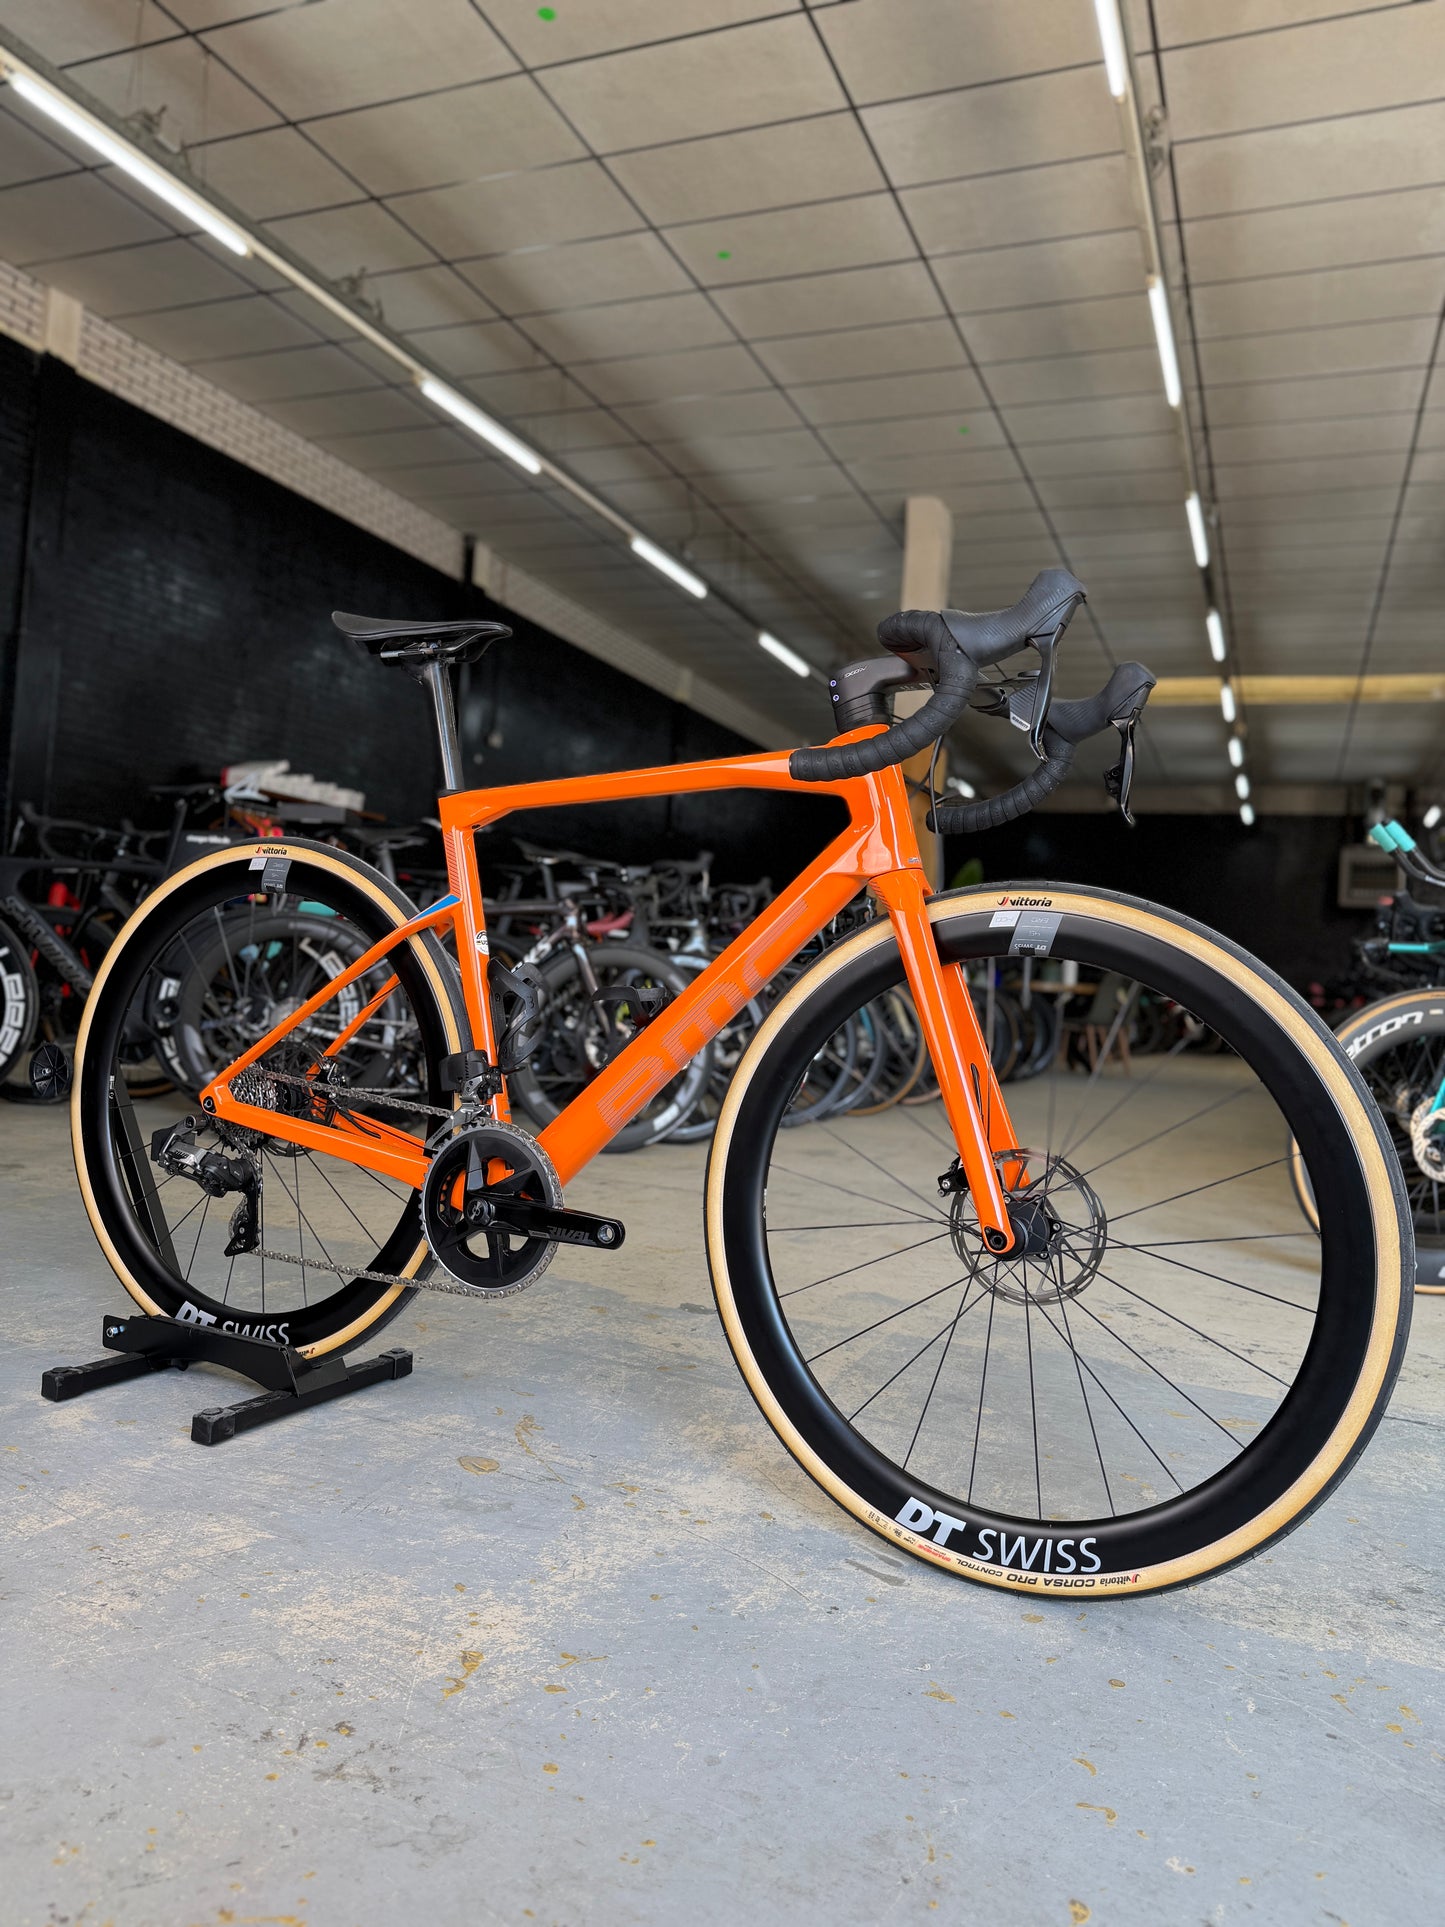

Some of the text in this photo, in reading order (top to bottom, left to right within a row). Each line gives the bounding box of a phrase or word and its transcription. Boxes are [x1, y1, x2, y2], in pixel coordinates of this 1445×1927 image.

[262, 846, 288, 856] vittoria
[1010, 896, 1053, 907] vittoria
[894, 1496, 1102, 1573] DT SWISS
[956, 1557, 1003, 1577] CONTROL
[1006, 1573, 1038, 1585] PRO
[1043, 1577, 1096, 1587] CORSA
[1099, 1575, 1131, 1586] vittoria
